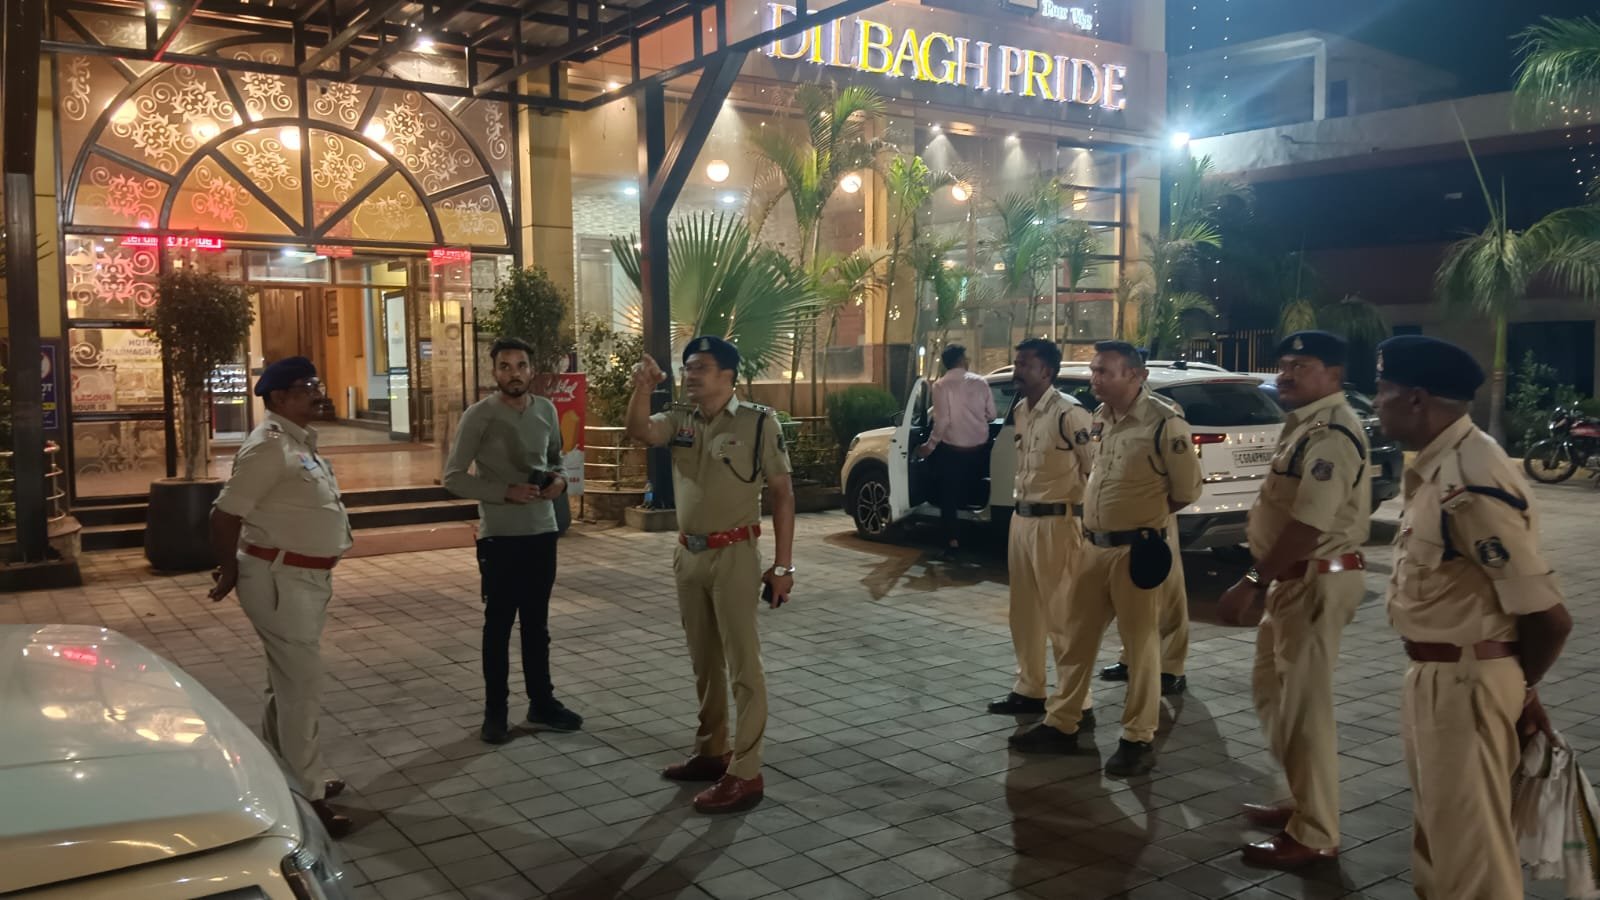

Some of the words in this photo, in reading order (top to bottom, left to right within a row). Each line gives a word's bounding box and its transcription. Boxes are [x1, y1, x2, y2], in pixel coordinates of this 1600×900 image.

[1070, 7, 1093, 30] Veg
[767, 3, 992, 92] DILBAGH
[997, 45, 1127, 111] PRIDE
[128, 339, 155, 347] HOTE
